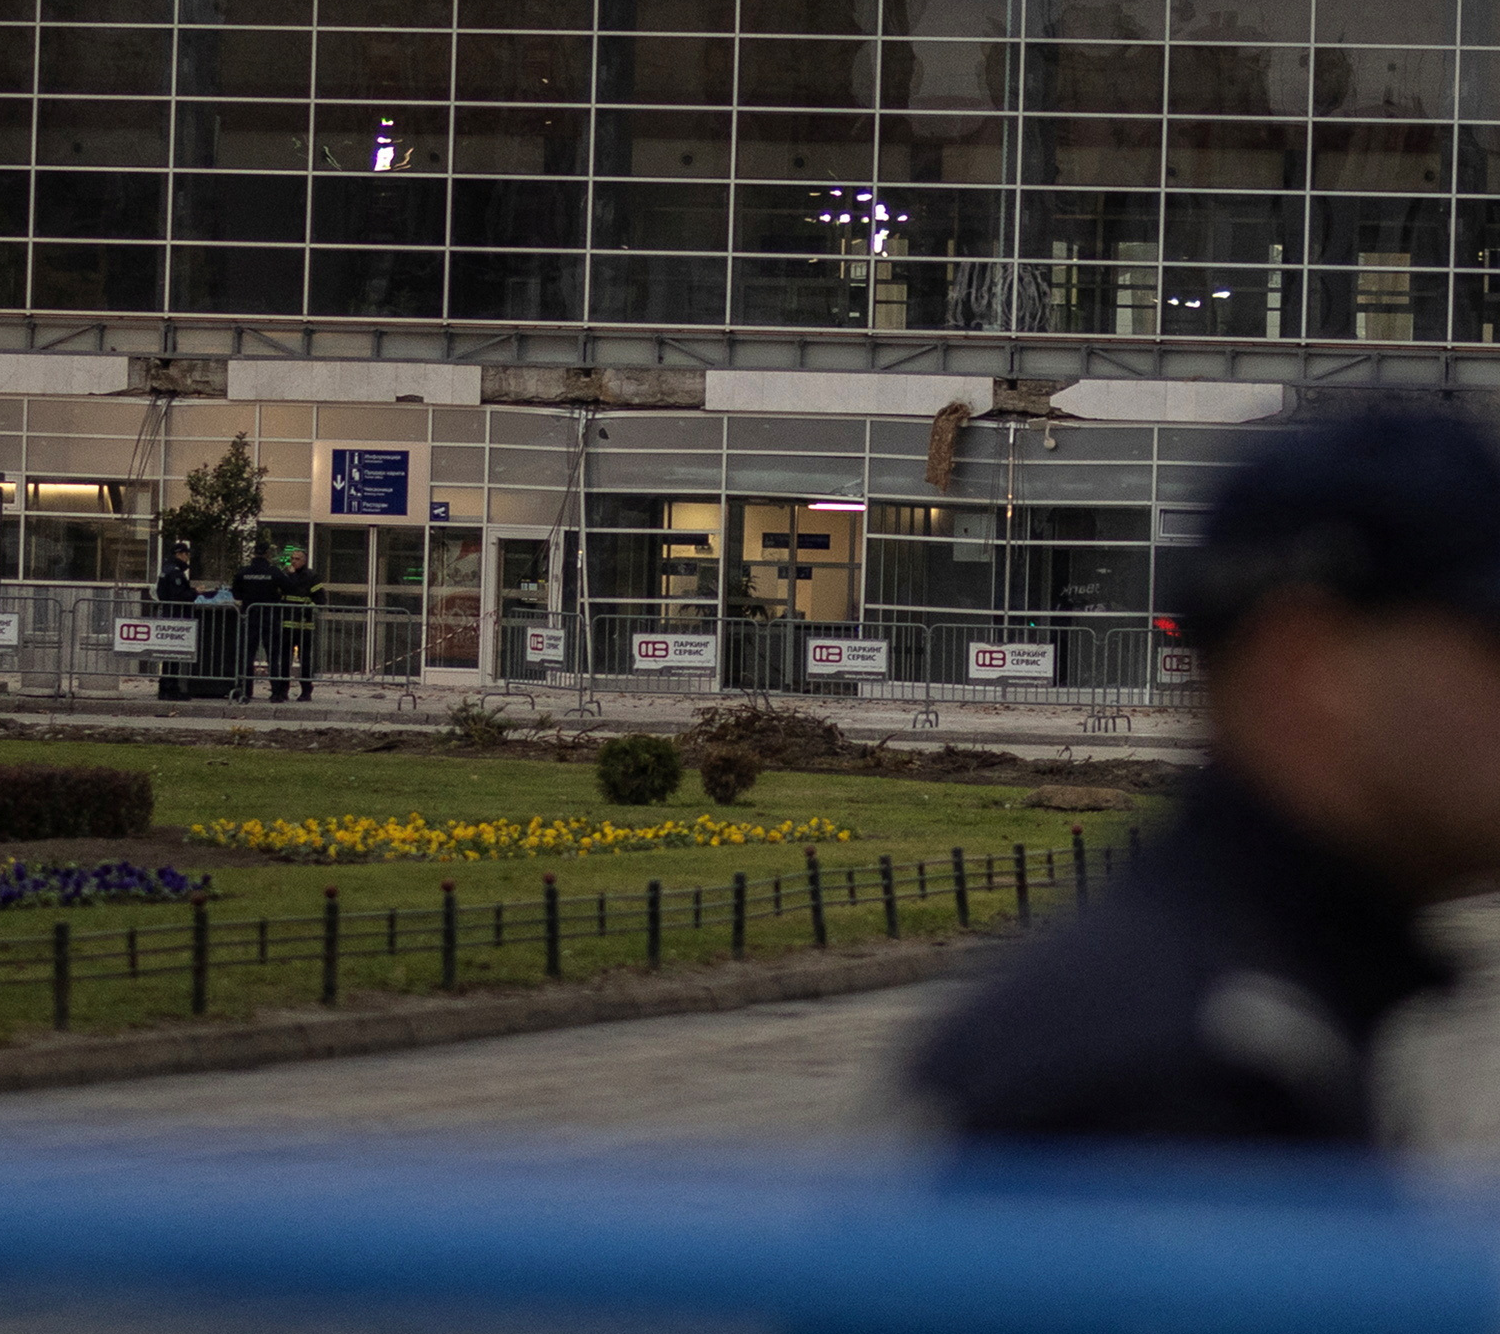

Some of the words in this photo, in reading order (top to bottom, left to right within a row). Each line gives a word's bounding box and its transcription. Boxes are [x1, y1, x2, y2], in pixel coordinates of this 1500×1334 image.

[155, 633, 186, 641] СЕРВИС
[673, 640, 710, 649] ПАРКИНГ
[673, 648, 704, 656] СЕРВИС
[846, 645, 883, 654] ПАРКИНГ
[846, 653, 878, 662] СЕРВИС
[1010, 650, 1048, 659] ПАРКИНГ
[1010, 658, 1042, 667] СЕРВИС
